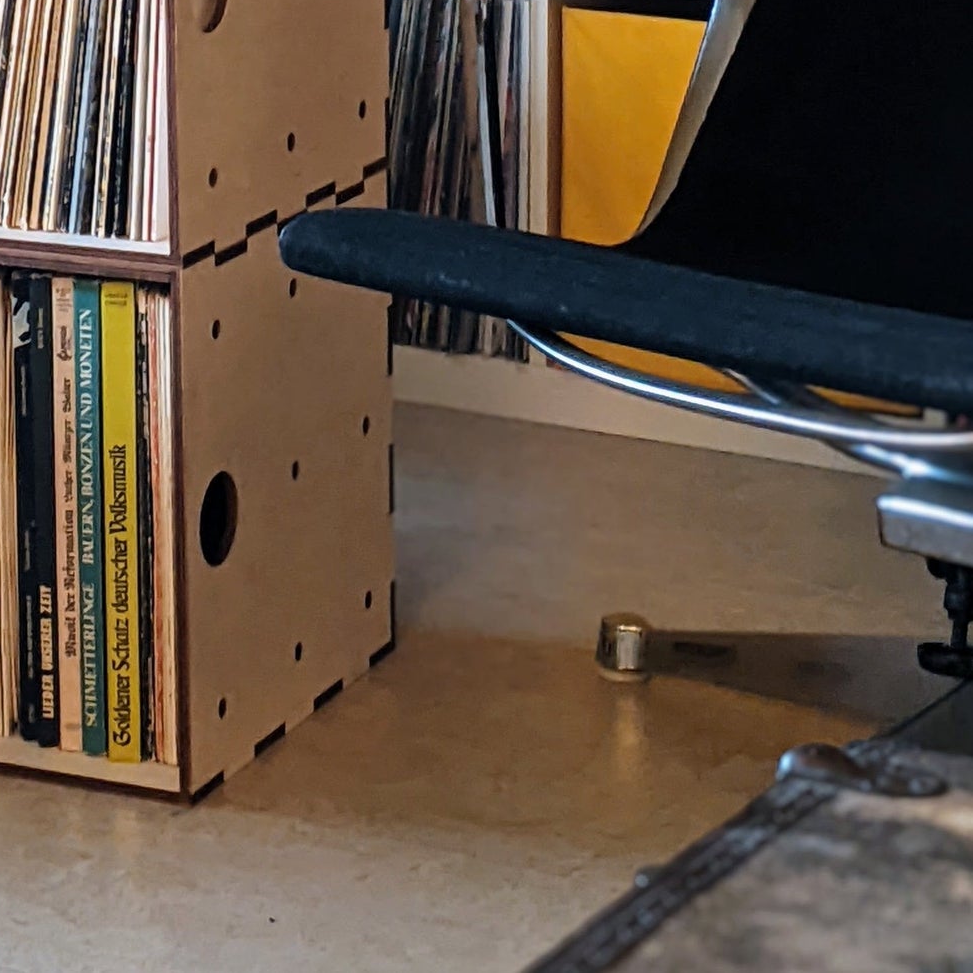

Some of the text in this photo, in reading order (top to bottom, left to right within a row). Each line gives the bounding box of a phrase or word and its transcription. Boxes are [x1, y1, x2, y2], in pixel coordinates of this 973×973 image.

[63, 510, 76, 589] Reformation
[79, 308, 97, 727] SCHMETTERLINGE BAUERN, BONZEN UND MONETEN
[39, 584, 55, 719] LIEDER UNSERER ZEIT
[64, 594, 76, 612] der
[108, 444, 131, 747] Goldener Schatz deutscher Volksmusik
